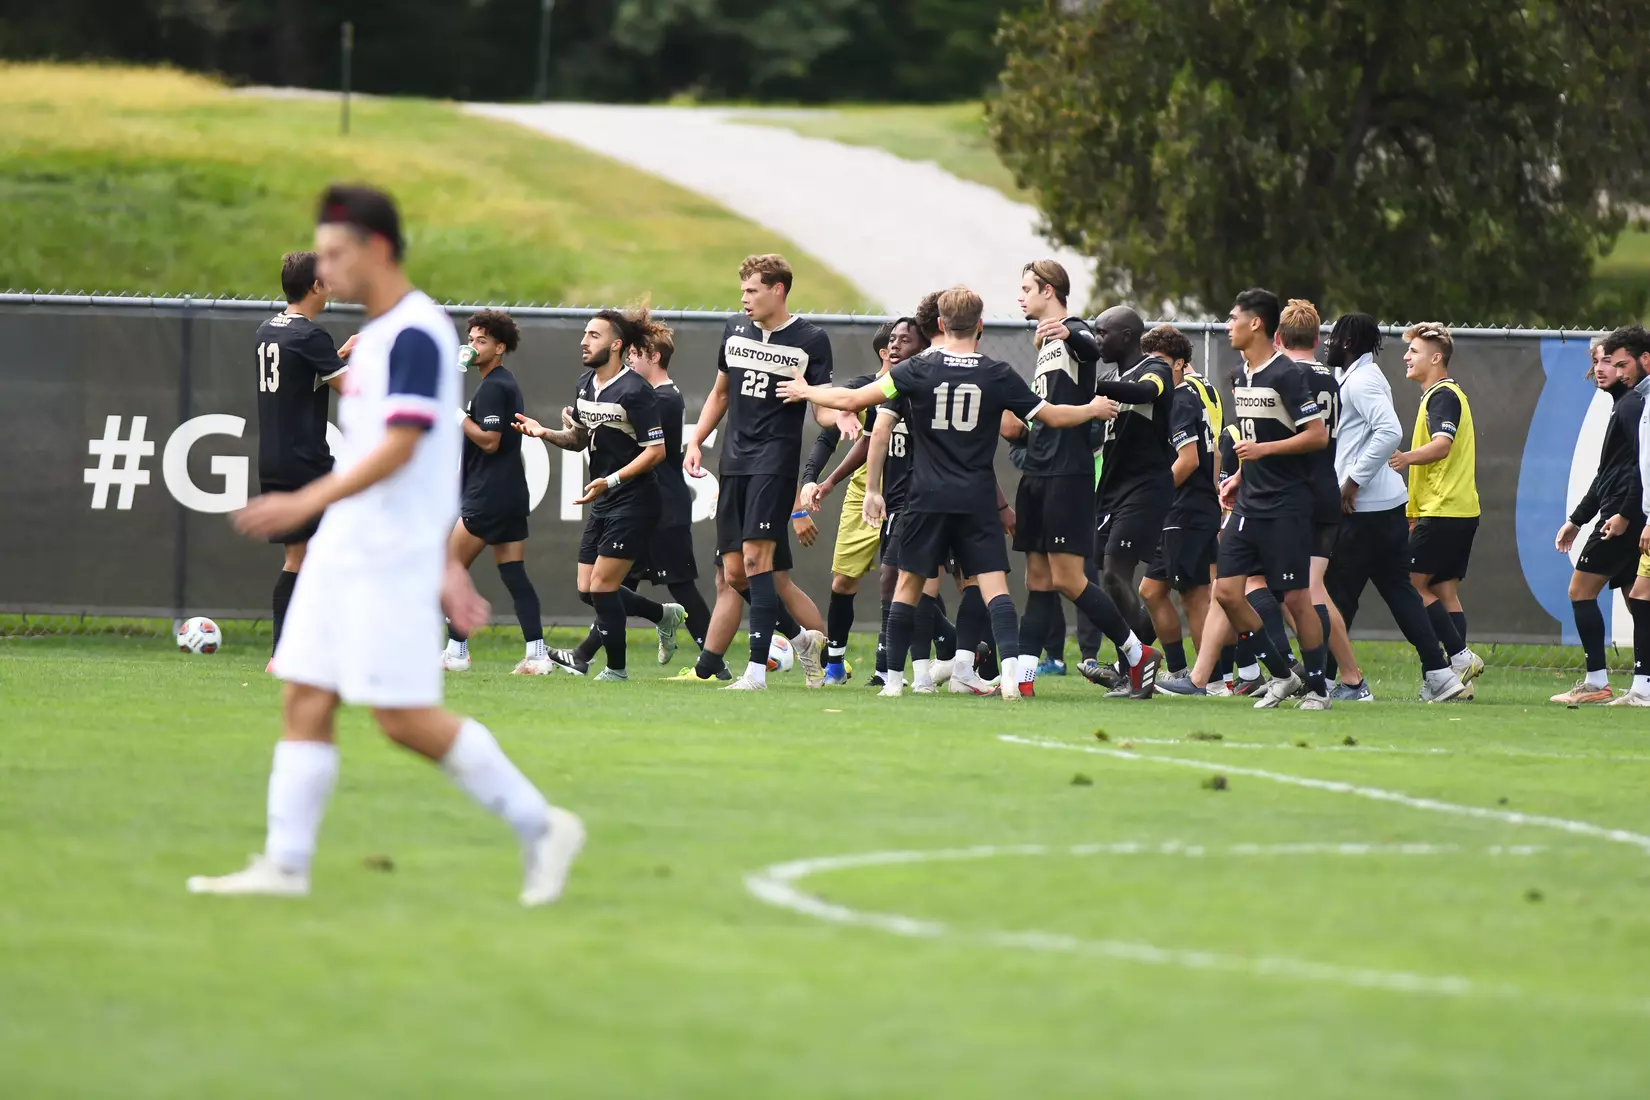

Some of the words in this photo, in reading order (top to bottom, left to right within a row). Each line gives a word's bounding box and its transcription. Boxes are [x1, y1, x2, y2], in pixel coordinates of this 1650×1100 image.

[257, 342, 280, 393] 13
[728, 346, 800, 367] MASTODONS
[740, 369, 770, 399] 22
[931, 381, 982, 432] 10
[1236, 396, 1276, 408] STODONS
[1240, 418, 1257, 443] 19
[888, 432, 906, 458] 18
